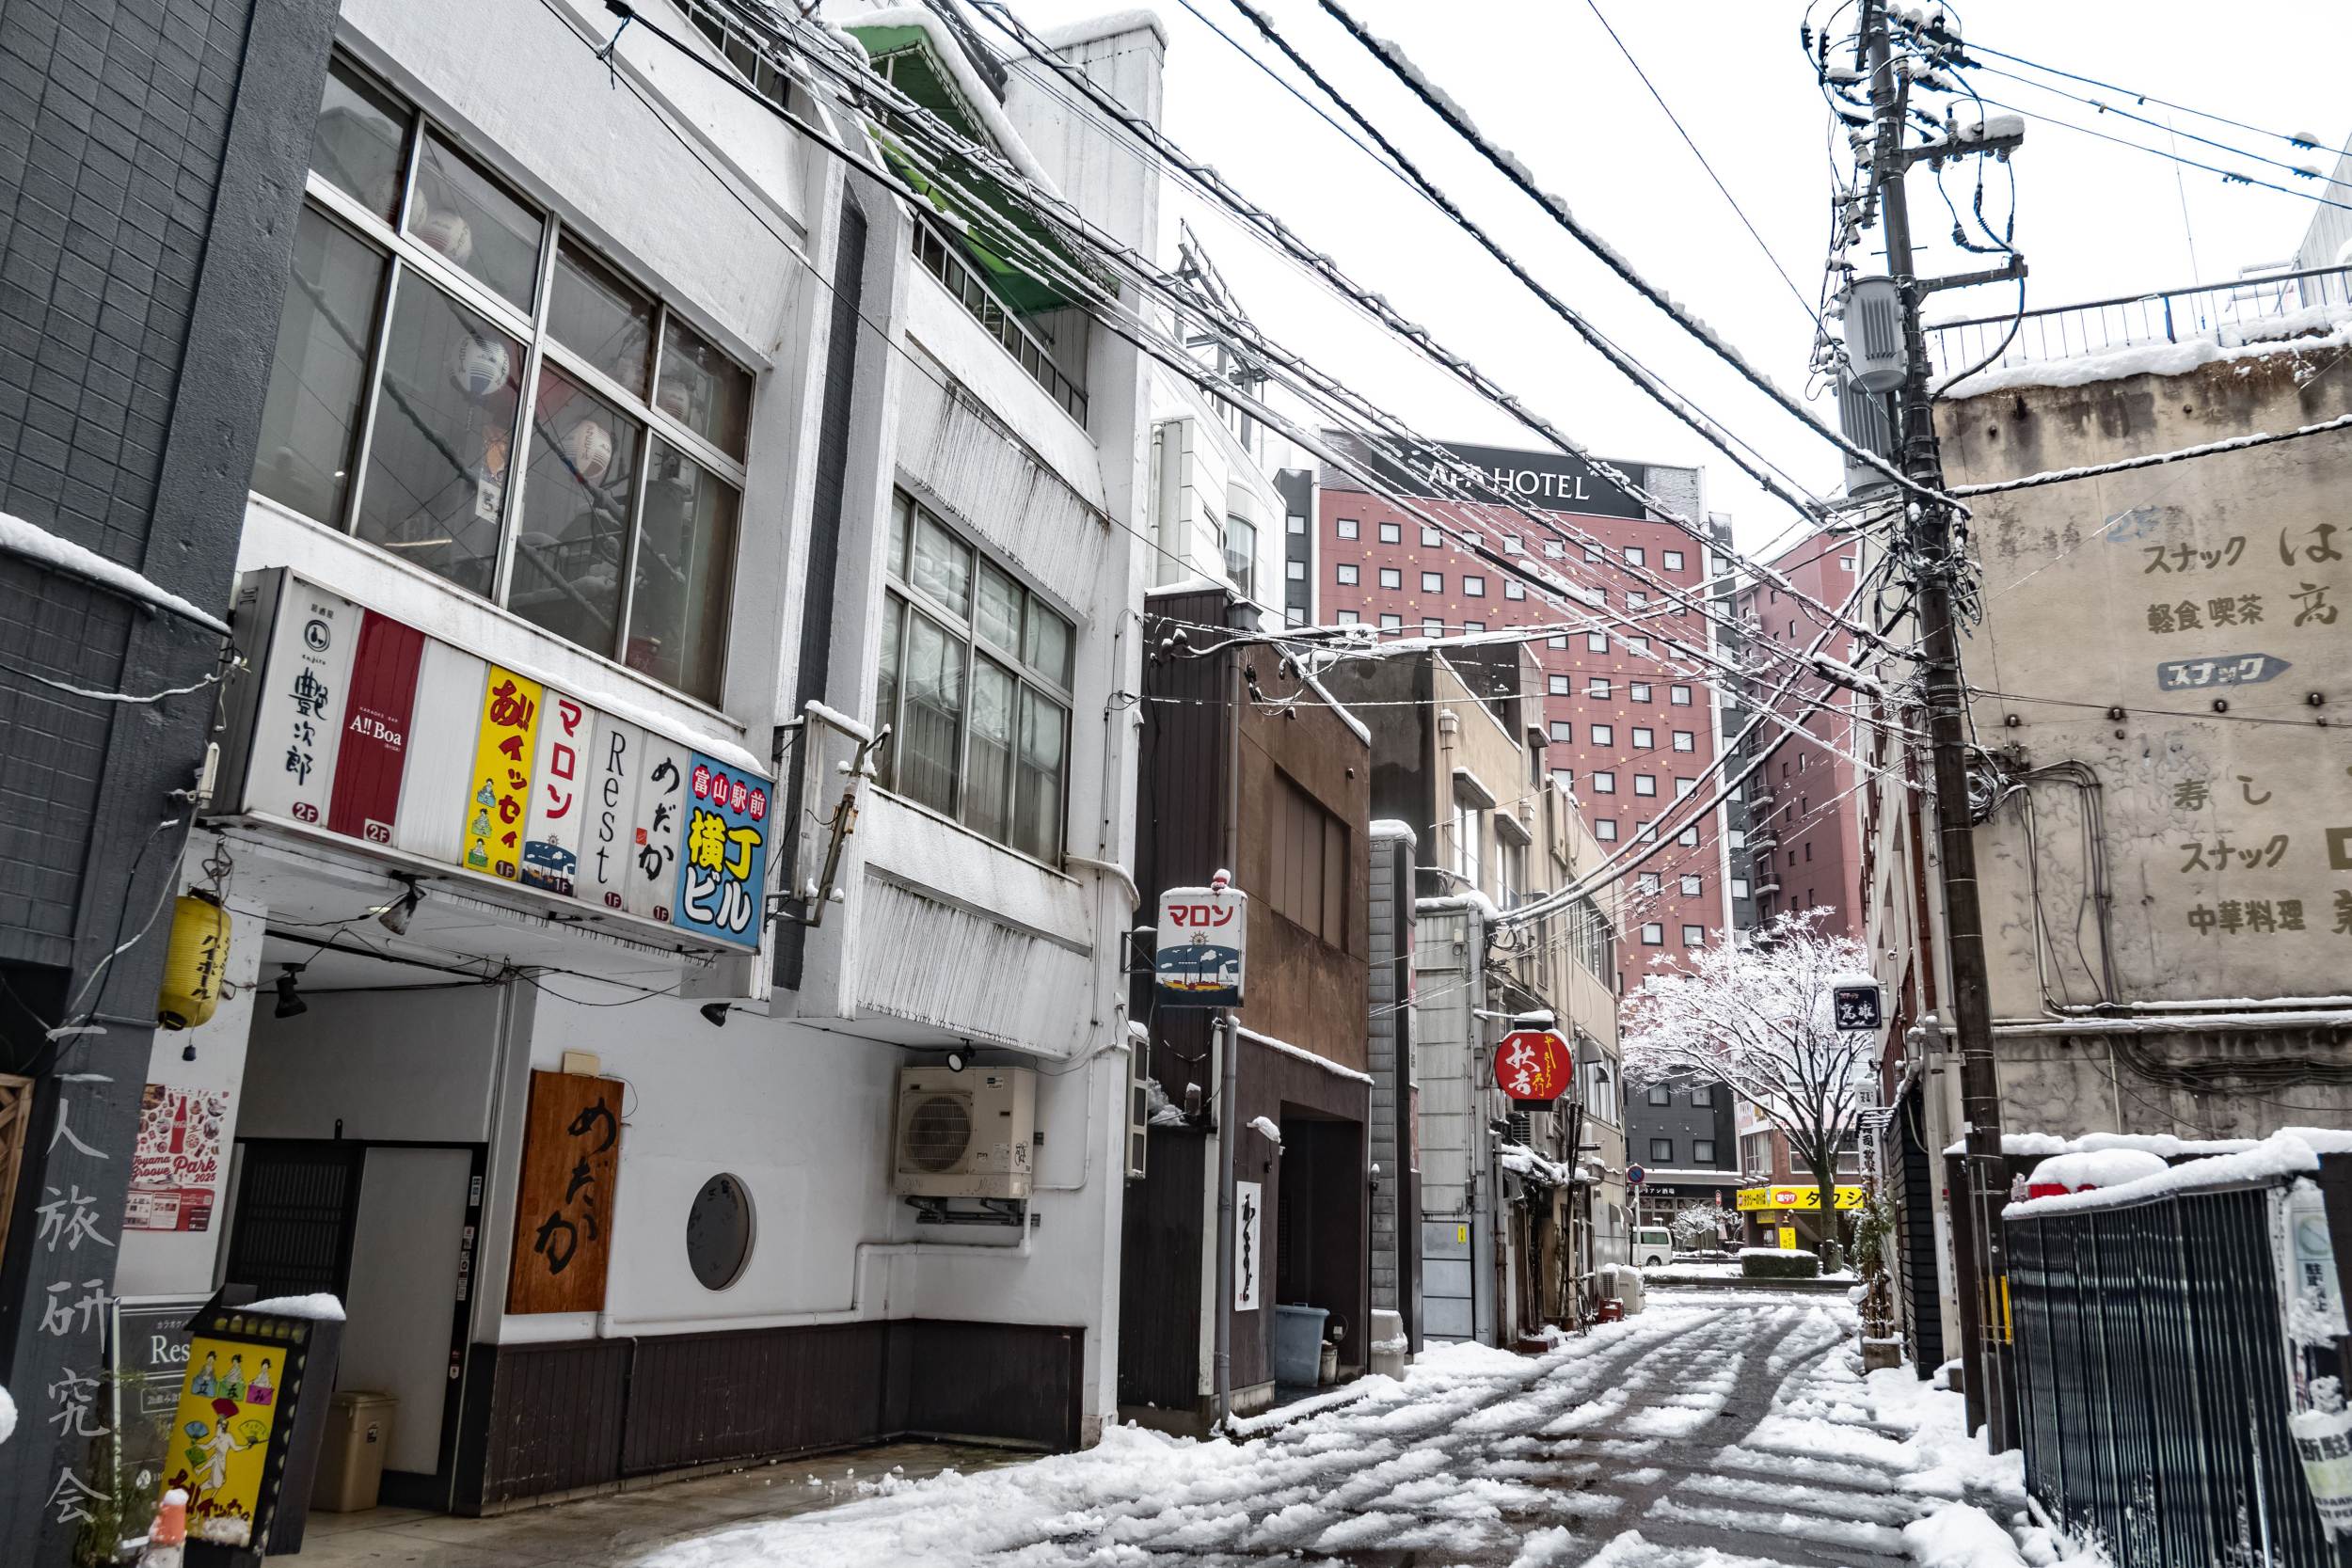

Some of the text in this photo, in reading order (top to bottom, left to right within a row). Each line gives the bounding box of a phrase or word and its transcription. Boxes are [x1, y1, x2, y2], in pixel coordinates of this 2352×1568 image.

[1493, 467, 1590, 500] HOTEL
[2143, 536, 2247, 574] スナック
[2148, 594, 2265, 634] 軽食喫茶
[2168, 657, 2265, 687] スナック
[349, 714, 402, 745] A!! Boa
[546, 698, 582, 819] マロン
[693, 768, 767, 819] 富山駅前
[294, 803, 317, 822] 2F
[638, 756, 680, 880] めだか
[367, 824, 389, 842] 2F
[689, 807, 763, 880] 横丁
[2180, 834, 2289, 873] スナック
[498, 862, 515, 878] 1F
[606, 893, 620, 907] 1F
[655, 908, 668, 922] 1F
[684, 866, 753, 934] ビル
[1168, 905, 1234, 927] マロン
[2187, 899, 2306, 936] 中華料理
[1505, 1037, 1541, 1096] 秋吉
[134, 1155, 171, 1167] Toyama
[173, 1155, 217, 1175] Park
[194, 1173, 216, 1182] 2025
